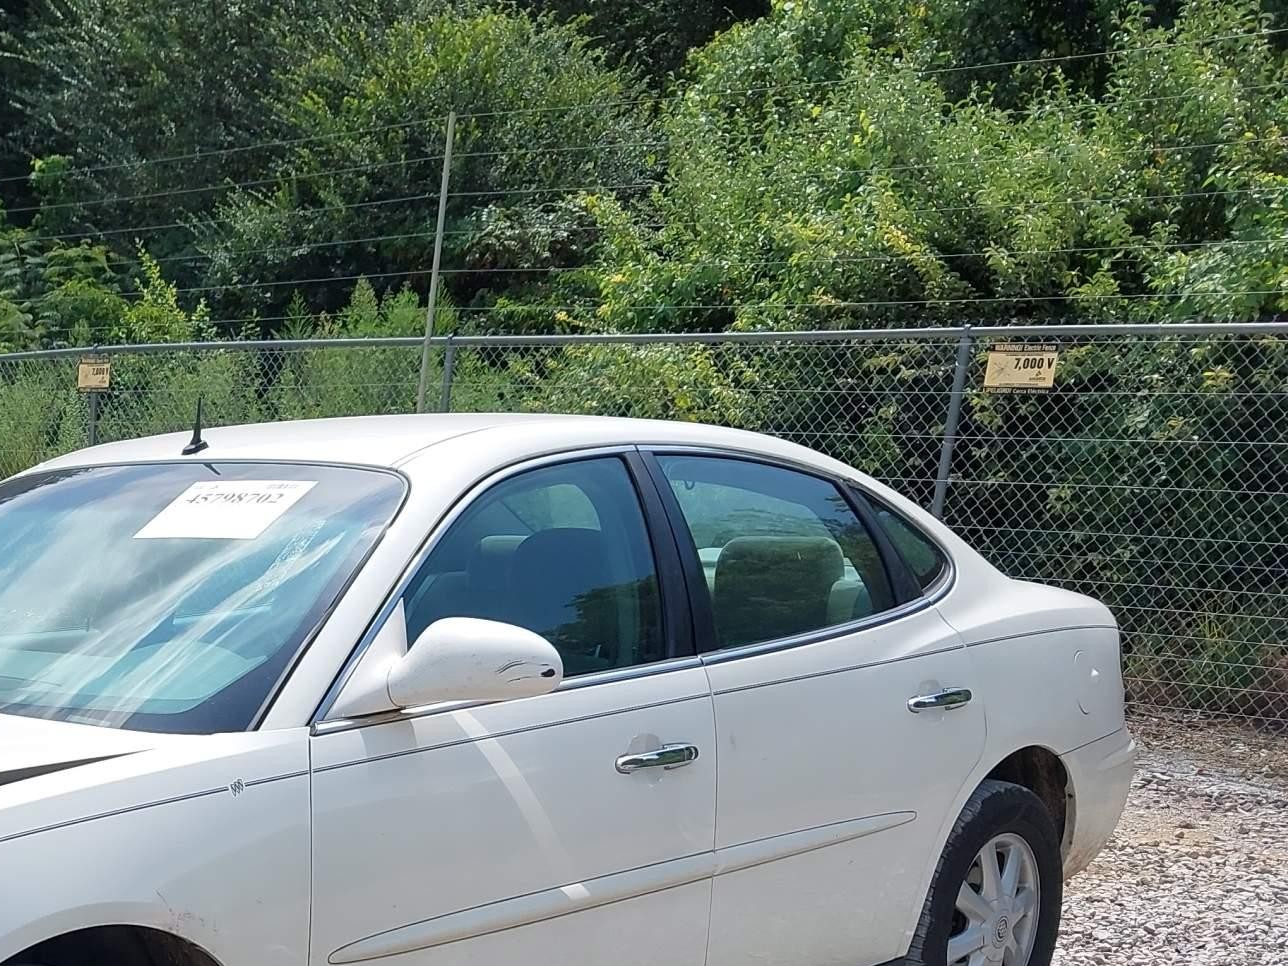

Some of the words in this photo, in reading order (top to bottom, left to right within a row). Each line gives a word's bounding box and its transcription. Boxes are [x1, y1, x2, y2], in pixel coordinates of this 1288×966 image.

[1014, 357, 1044, 371] 7,000
[1047, 357, 1055, 369] V
[185, 492, 284, 504] 45798702
